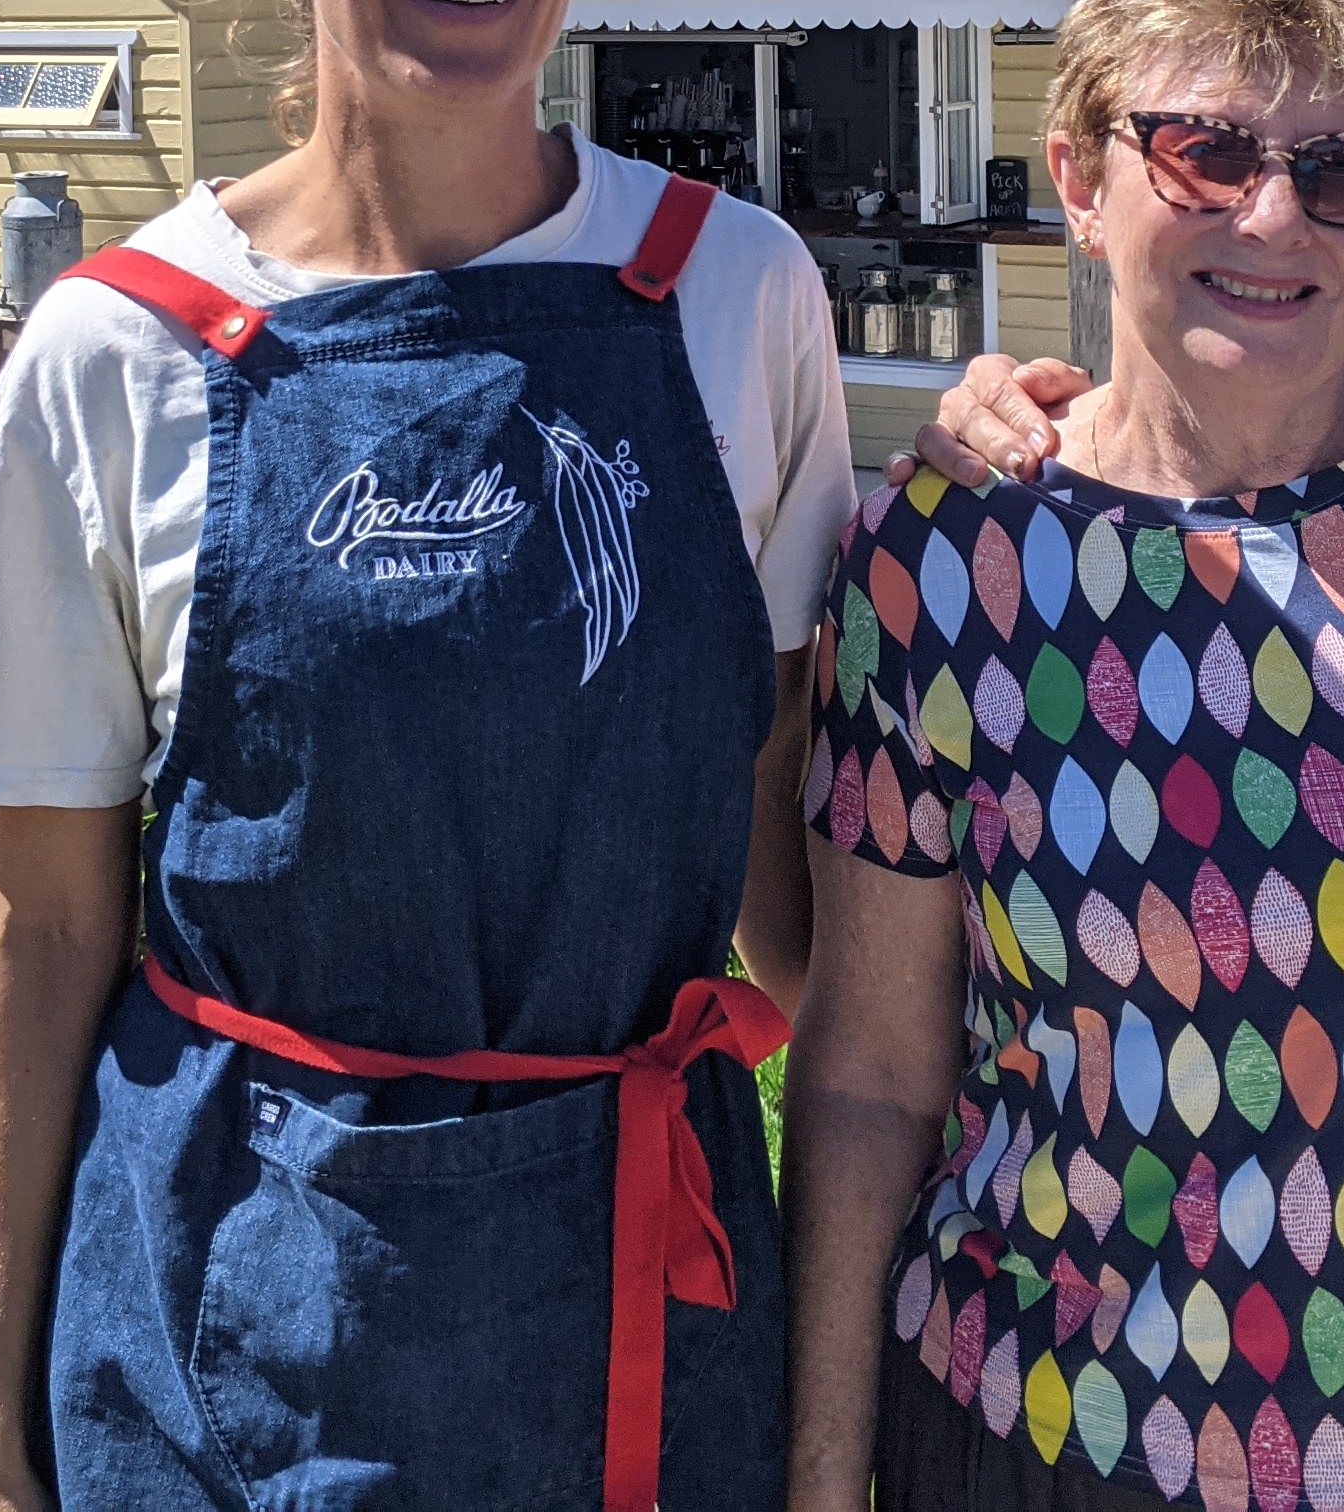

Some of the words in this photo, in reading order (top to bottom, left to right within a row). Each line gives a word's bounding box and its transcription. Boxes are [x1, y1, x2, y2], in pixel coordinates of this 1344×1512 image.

[990, 171, 1024, 191] PICK
[307, 460, 527, 569] Bodalla
[373, 549, 480, 581] DAIRY
